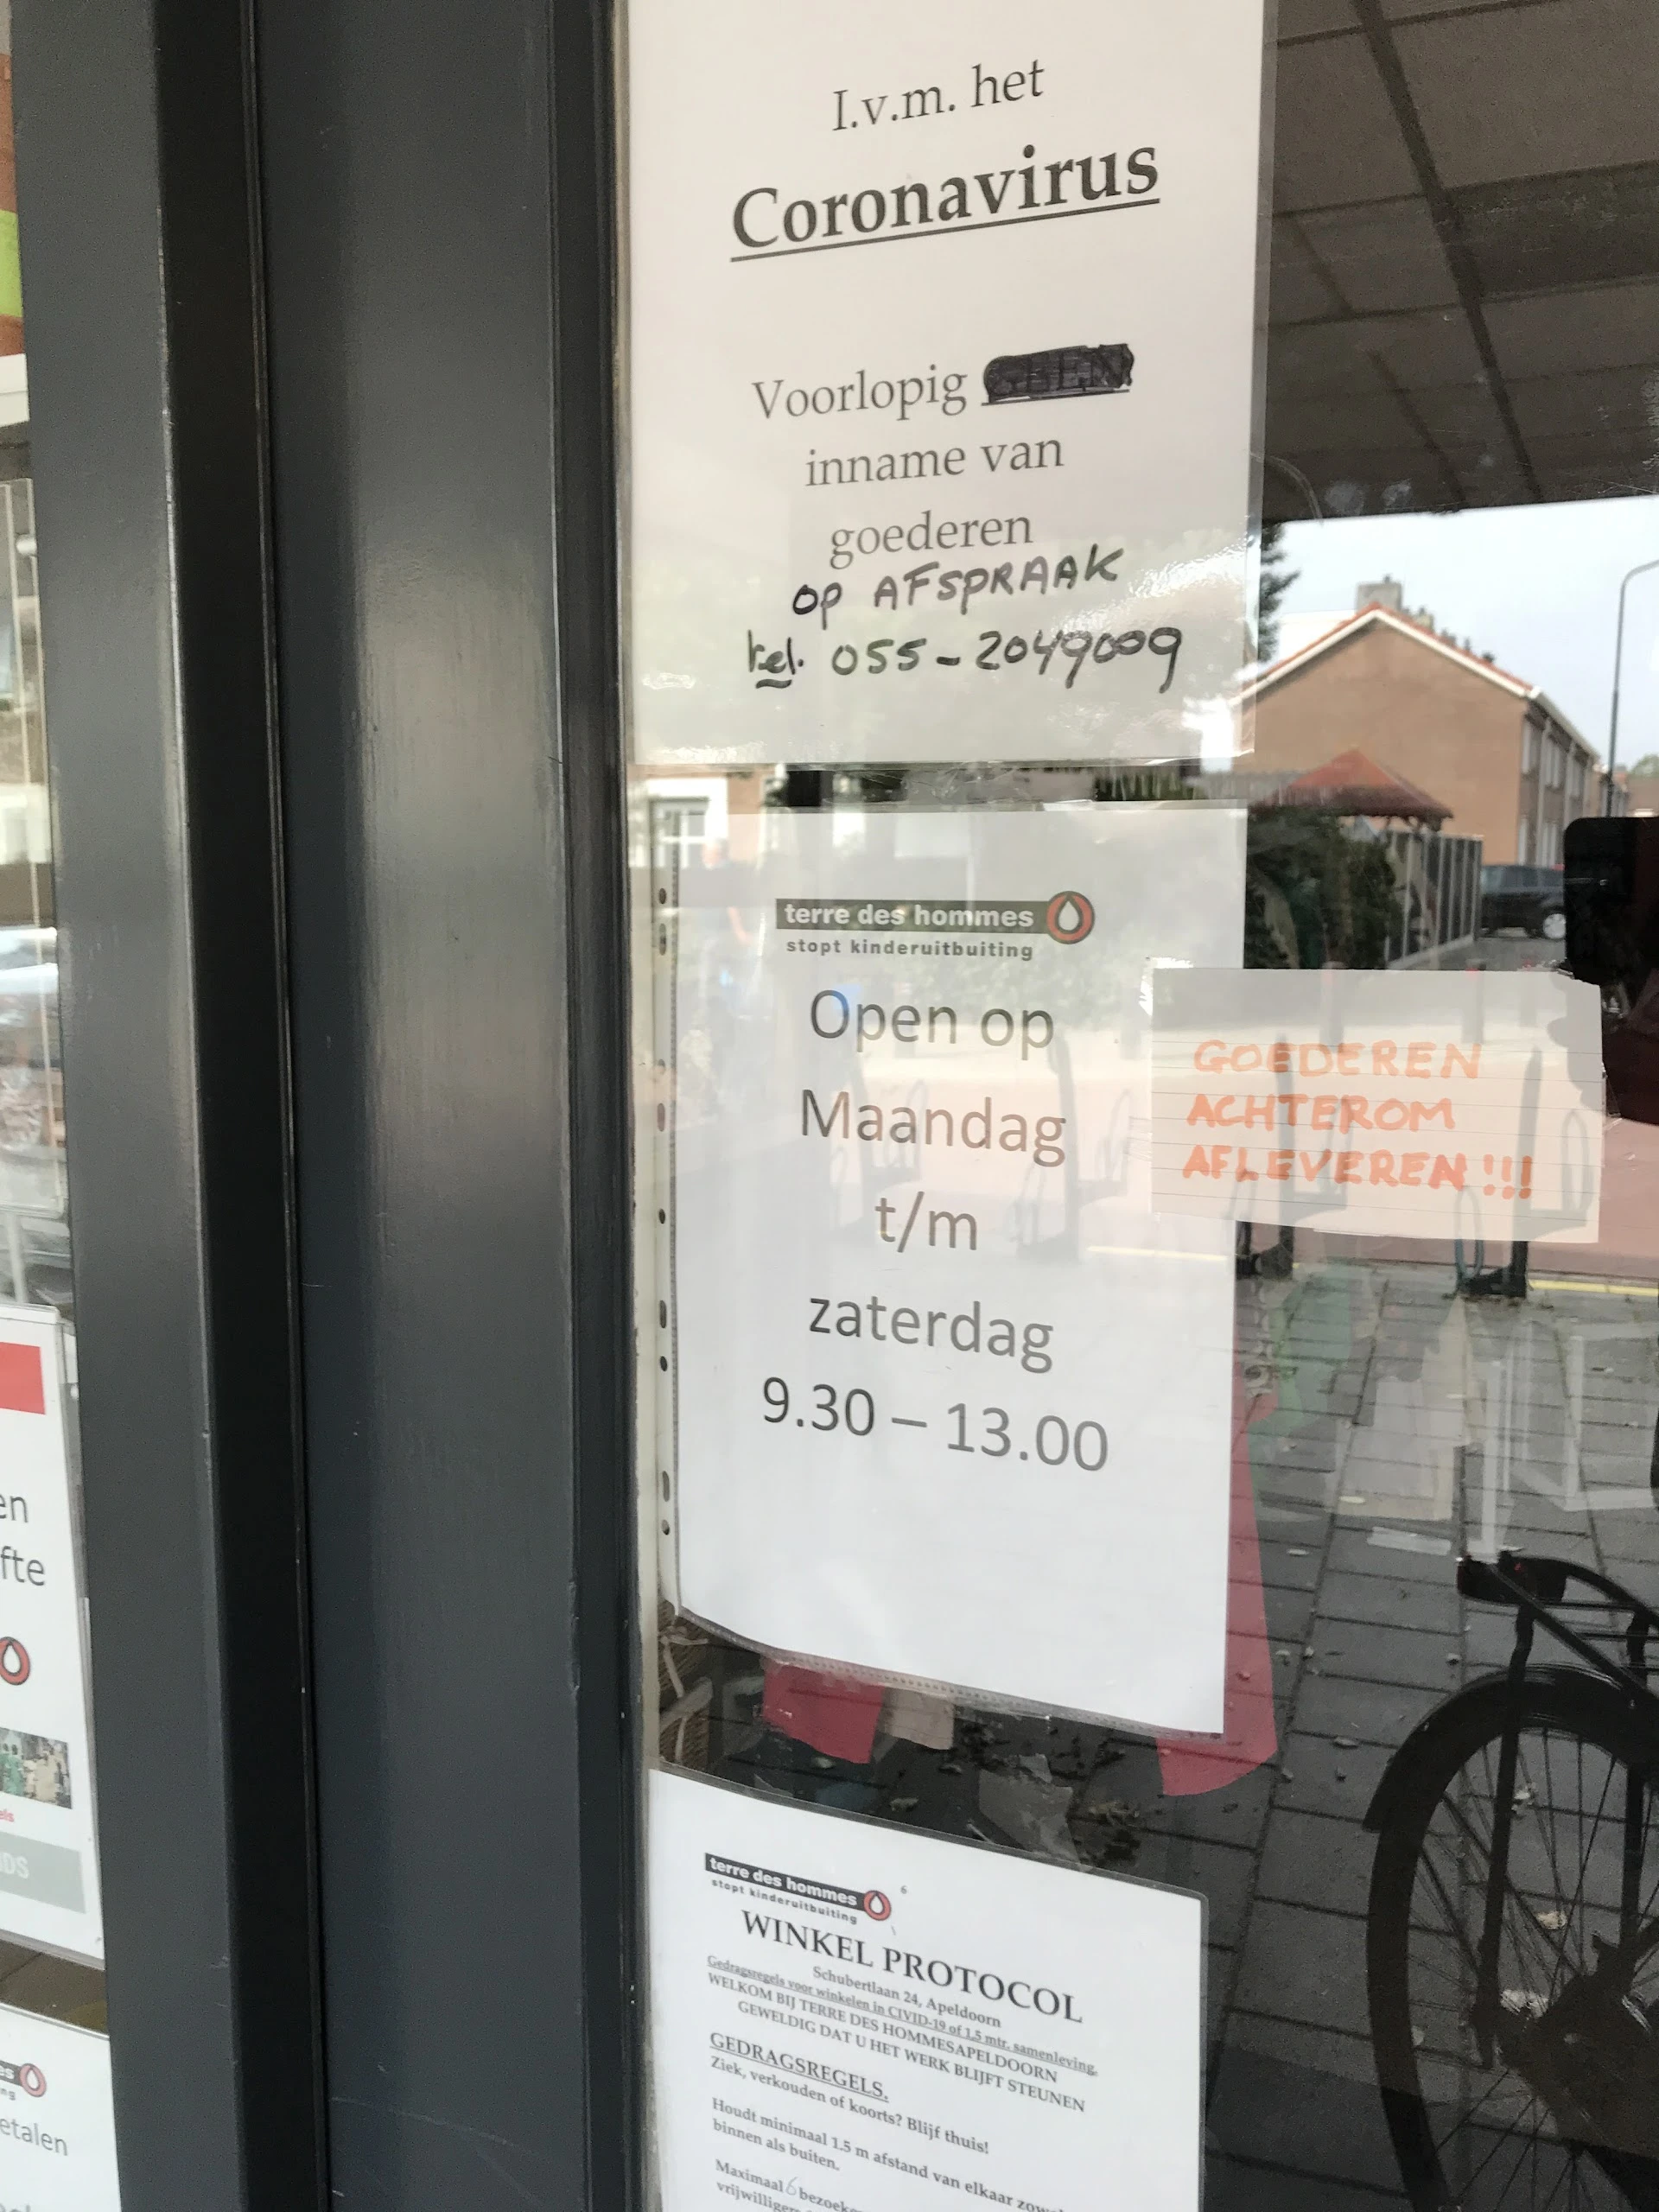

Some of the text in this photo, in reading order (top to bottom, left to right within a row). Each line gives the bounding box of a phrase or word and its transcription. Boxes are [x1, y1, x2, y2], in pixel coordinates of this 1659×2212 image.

[831, 59, 1046, 131] I.v.m. het
[731, 143, 1160, 254] Coronavirus
[752, 364, 968, 421] Voorlopig
[804, 438, 1065, 486] inname van
[830, 510, 1034, 570] goederen
[874, 543, 1124, 615] AFSPRAAK
[785, 904, 1033, 927] terre des hommes
[786, 938, 1033, 962] stopt kinderuitbuiting
[810, 989, 1054, 1061] Open op
[1193, 1039, 1482, 1079] GOEDEREN
[802, 1089, 1066, 1167] Maandag
[1186, 1093, 1455, 1134] ACHTEROM
[875, 1191, 977, 1253] t/m
[810, 1296, 1054, 1374] zaterdag
[763, 1376, 874, 1436] 9.30
[947, 1402, 1109, 1471] 13.00
[709, 1858, 858, 1906] terre des hommes
[712, 1878, 858, 1925] stopt kinderuitbuiting
[741, 1910, 1083, 2024] WINKEL PROTOCOL
[812, 1966, 1001, 2028] Schubertlaan 24, Apeldoorn
[707, 1955, 785, 1986] Gedragsregels
[788, 1980, 814, 1995] voor
[815, 1988, 870, 2012] winkelen
[873, 2002, 886, 2015] in
[888, 2005, 946, 2031] CIVID-19
[949, 2025, 963, 2036] of
[985, 2036, 1010, 2050] mtr.
[708, 1973, 772, 2000] WELKOM
[776, 1997, 796, 2010] BIJ
[798, 1999, 846, 2022] TERRE
[849, 2012, 880, 2031] DES
[709, 2032, 889, 2101] GEDRAGSREGELS.
[738, 2001, 1085, 2113] GEWELDIG DAT U HET WERK BLIJFT STEUNEN
[710, 2056, 989, 2154] Ziek, verkouden of koorts? Blijf thuis!
[712, 2118, 841, 2171] binnen als buiten.
[712, 2097, 757, 2122] Houdt
[760, 2115, 828, 2145] minimaal
[855, 2146, 869, 2160] m
[873, 2152, 928, 2179] afstand
[933, 2171, 961, 2190] van
[964, 2181, 1014, 2207] elkaar
[715, 2158, 784, 2192] Maximaal
